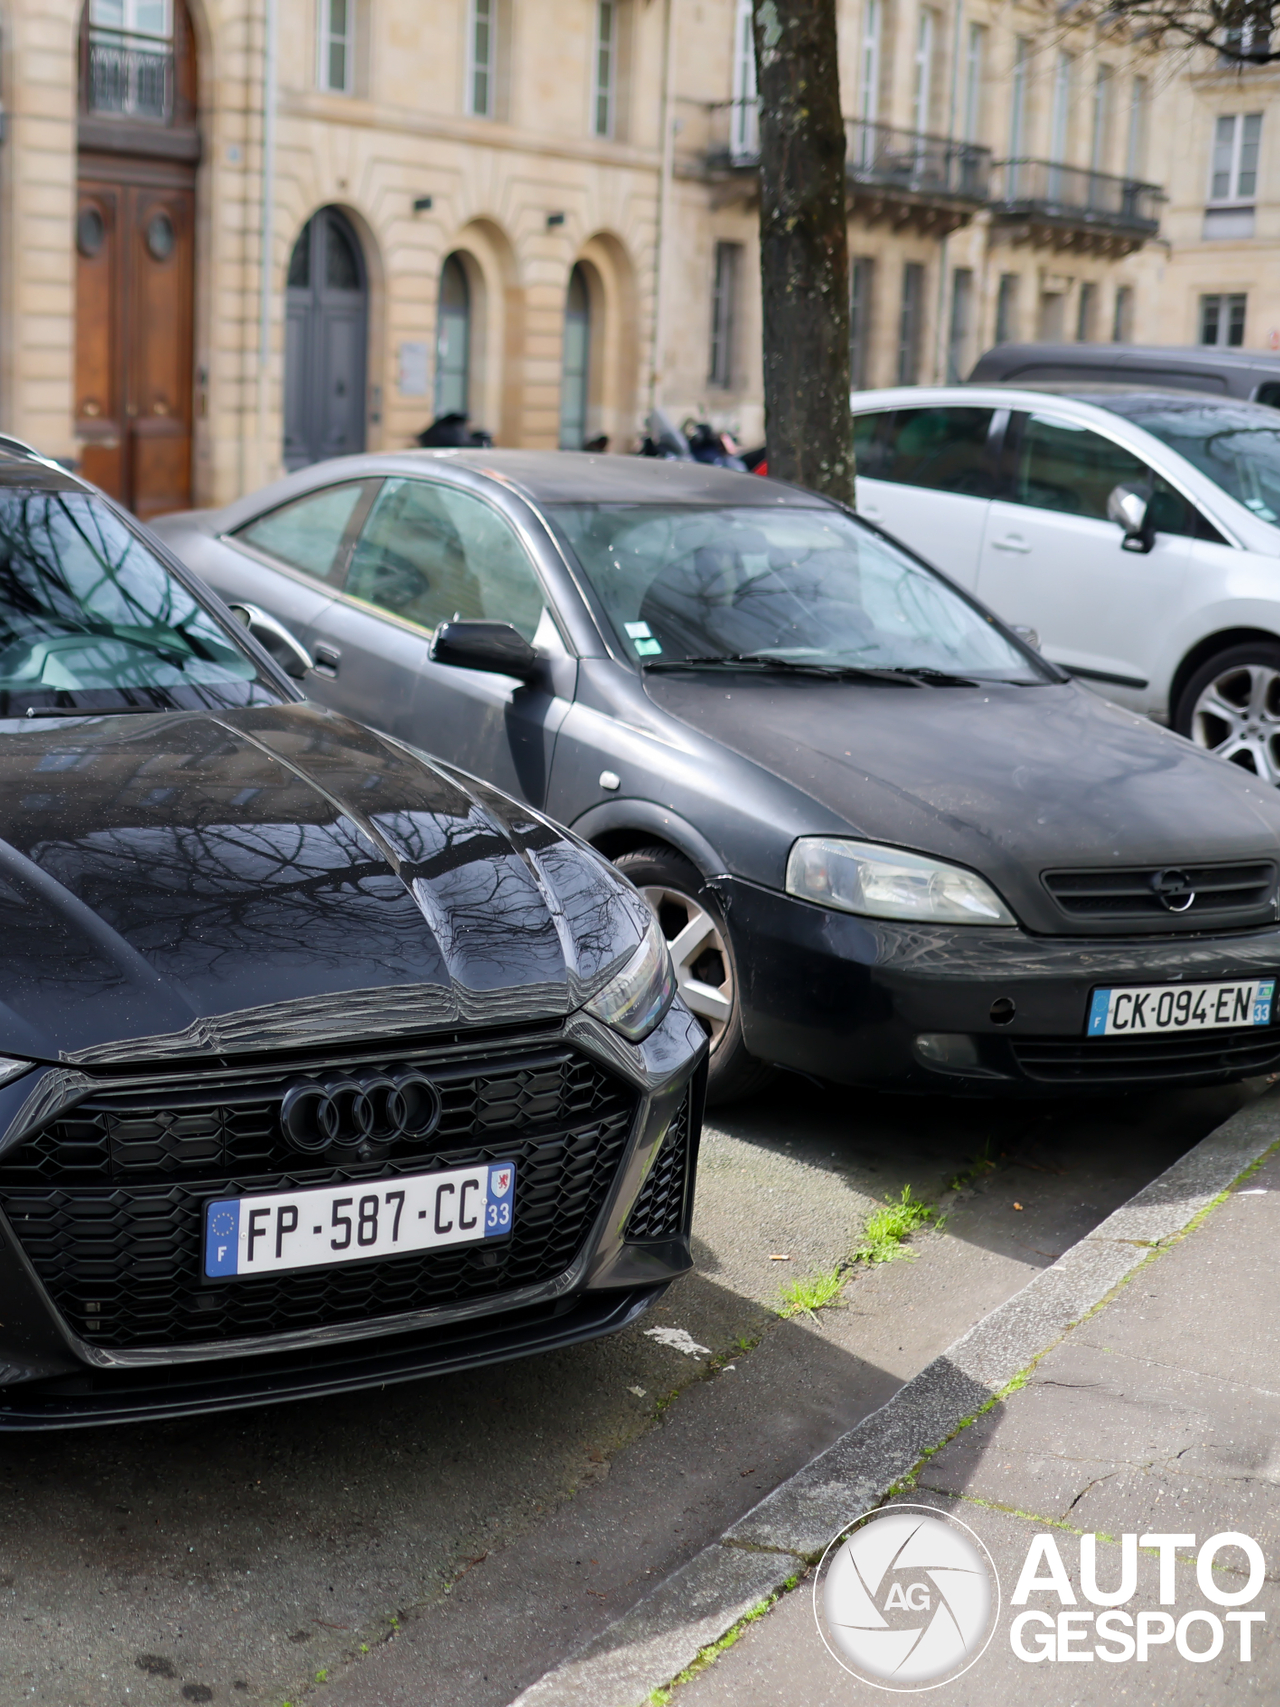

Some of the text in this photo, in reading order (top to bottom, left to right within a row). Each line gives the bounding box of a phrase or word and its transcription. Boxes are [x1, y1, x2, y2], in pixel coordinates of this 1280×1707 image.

[1094, 986, 1270, 1030] F CK-094-EN 33
[217, 1179, 510, 1262] F FP-587-CC 33
